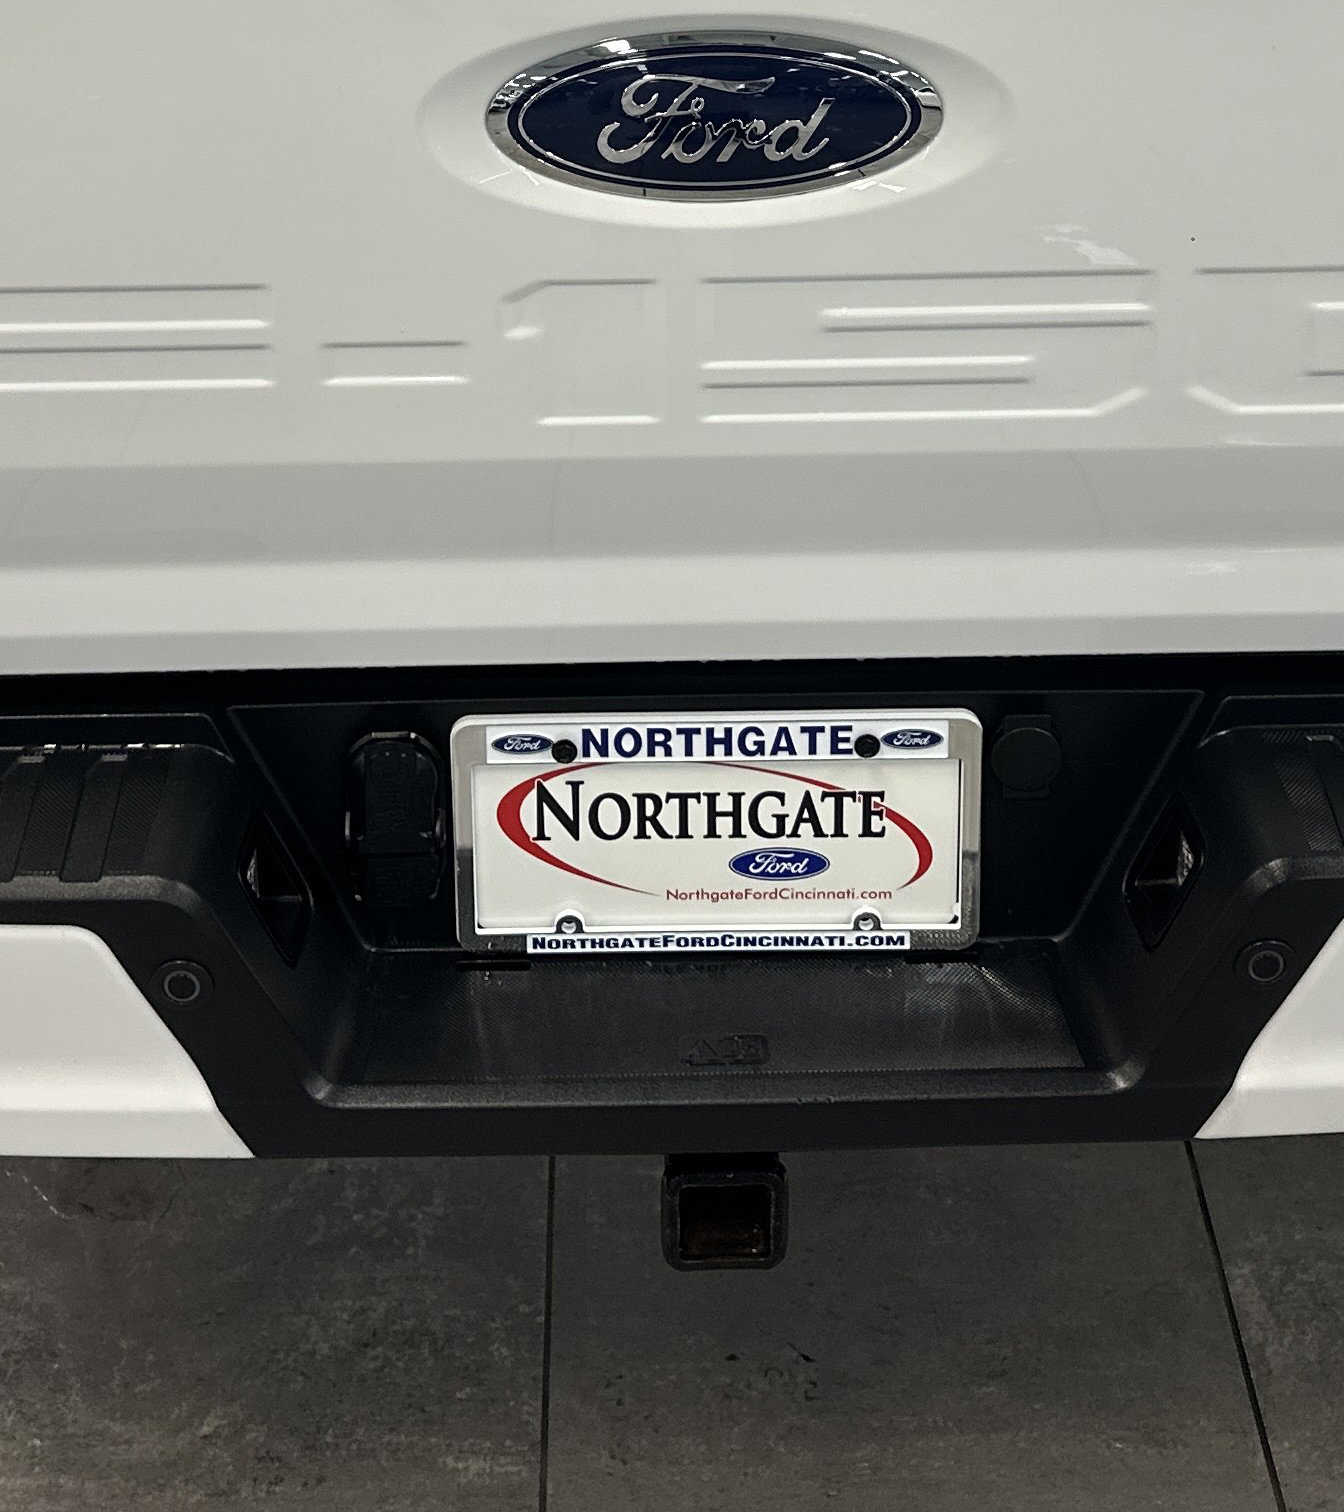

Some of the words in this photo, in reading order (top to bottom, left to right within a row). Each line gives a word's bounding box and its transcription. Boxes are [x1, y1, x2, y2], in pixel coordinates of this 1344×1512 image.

[597, 73, 835, 164] Ford
[581, 725, 854, 759] NORTHGATE
[532, 779, 887, 842] NORTHGATE
[666, 887, 893, 903] NorthgateFordCincinnati.com
